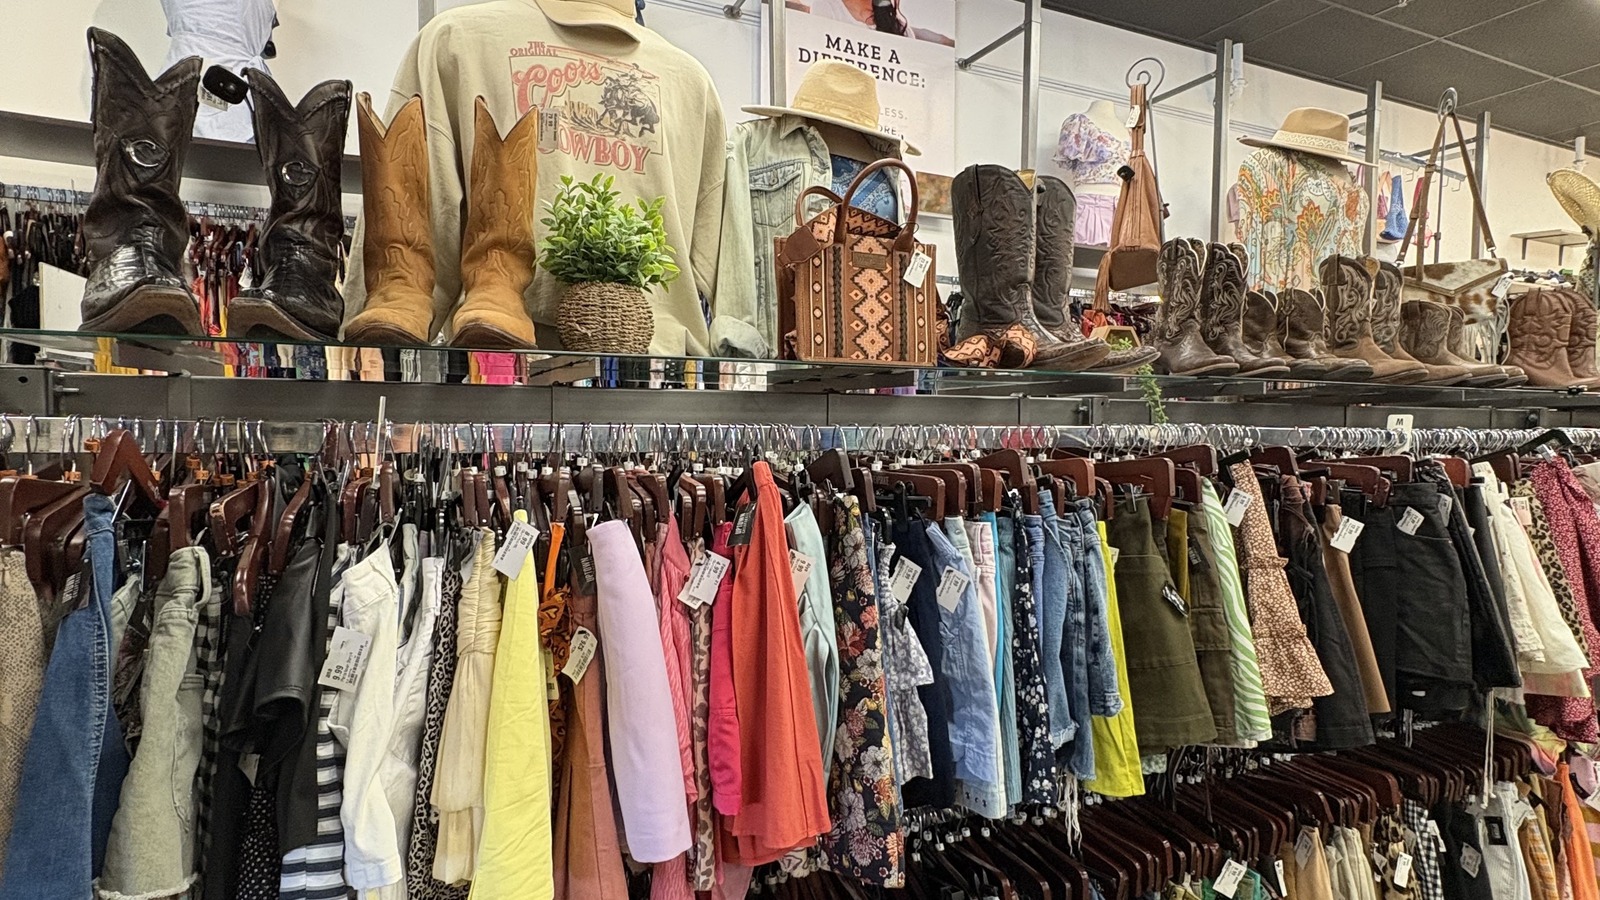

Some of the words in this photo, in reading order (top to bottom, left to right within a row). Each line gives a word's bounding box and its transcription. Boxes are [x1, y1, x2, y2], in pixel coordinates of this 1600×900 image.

[509, 47, 558, 57] ORIGINAL
[528, 41, 546, 50] THE
[825, 34, 881, 60] MAKE
[888, 50, 901, 65] A
[798, 47, 926, 88] DIRENCE:
[511, 58, 604, 116] Coors
[540, 124, 652, 175] OWBOY
[1395, 417, 1404, 426] M
[519, 530, 530, 545] 8.99
[712, 560, 721, 573] 4.99
[716, 563, 725, 579] Forever
[331, 664, 344, 681] 9.99
